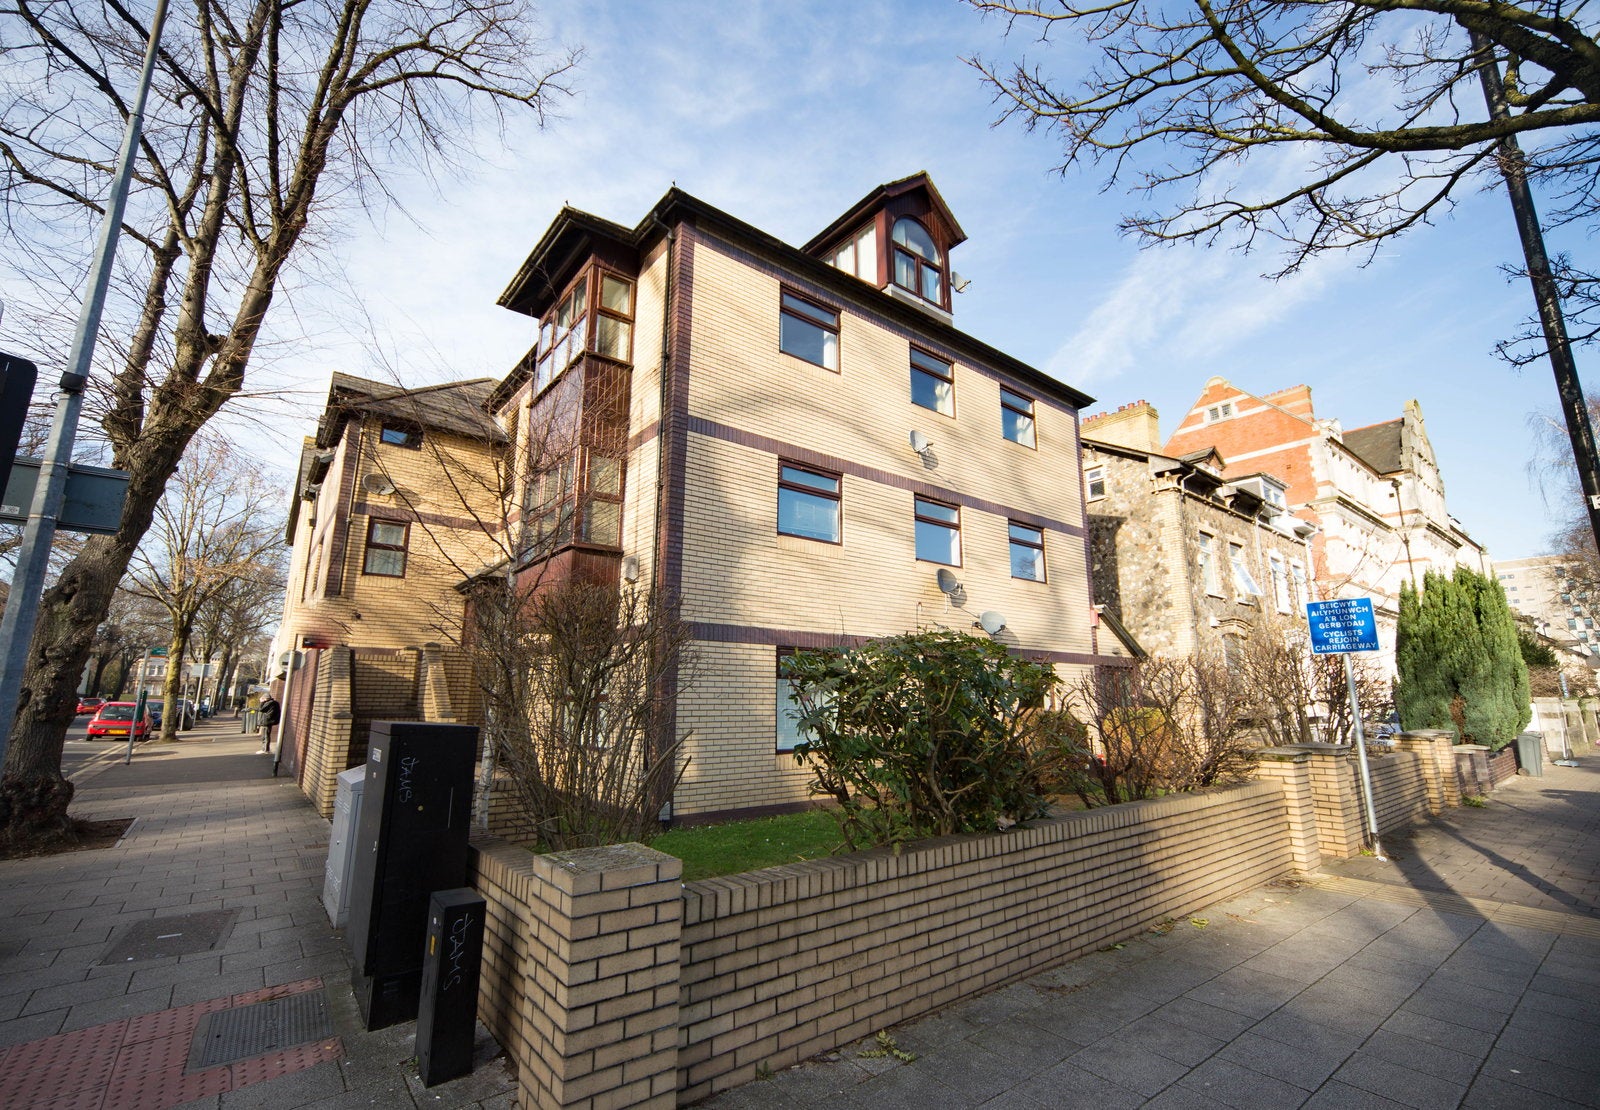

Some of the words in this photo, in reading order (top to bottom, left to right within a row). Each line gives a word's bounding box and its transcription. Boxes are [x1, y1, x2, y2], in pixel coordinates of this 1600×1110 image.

[1320, 600, 1357, 610] BEICWYR
[1311, 606, 1368, 616] AILYMUNWCH
[1319, 620, 1364, 629] GERBYDAU
[1323, 630, 1363, 638] CYCLISTS
[1315, 642, 1376, 651] CARRIAGEWAY
